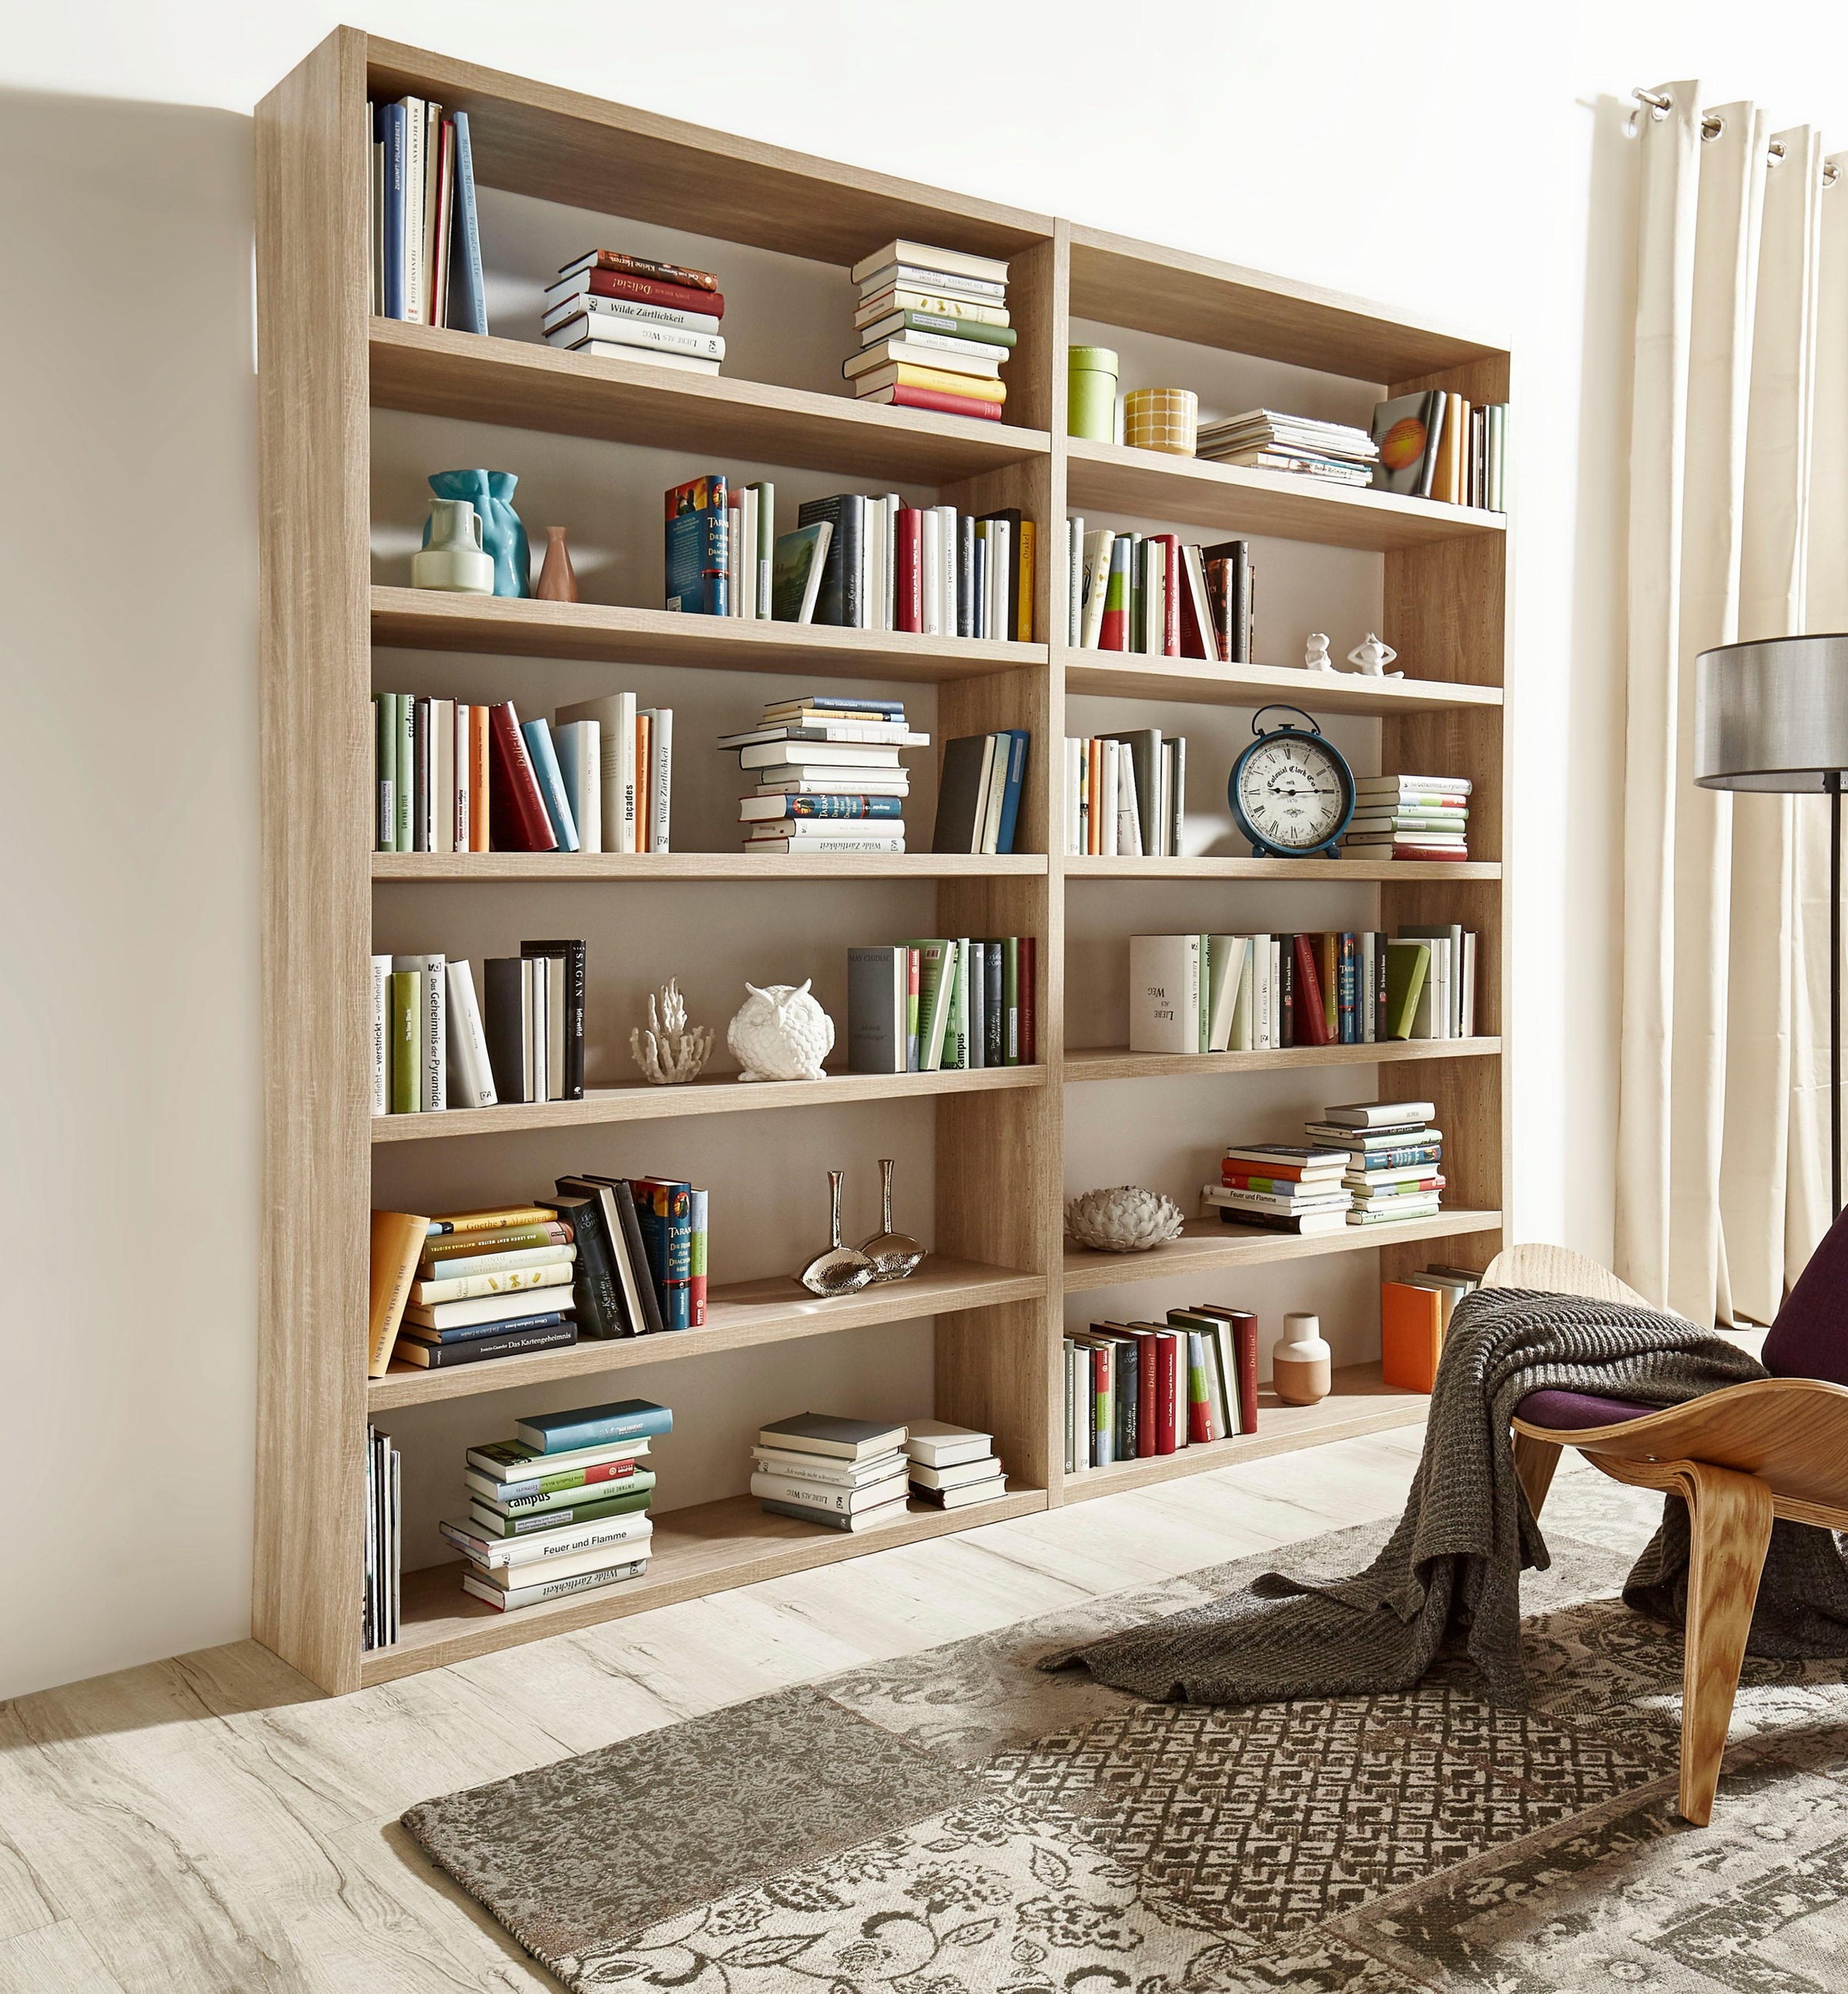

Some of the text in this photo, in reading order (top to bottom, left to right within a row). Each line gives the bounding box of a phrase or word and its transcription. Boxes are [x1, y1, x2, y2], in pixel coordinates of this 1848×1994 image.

[634, 260, 655, 272] Kleine
[612, 278, 652, 295] Delizia!
[611, 303, 684, 323] Wilde Zärtlichkeit
[507, 726, 527, 768] Delizia!
[1267, 766, 1287, 788] Colonial
[1289, 765, 1307, 778] Clock
[660, 747, 669, 824] Wilde Zärtlichkeit
[624, 785, 634, 821] façades
[849, 954, 892, 963] MAY CHIDIAC
[1147, 987, 1165, 998] WEG
[430, 992, 440, 1044] Geheimnis
[1154, 1010, 1174, 1021] LIEBE
[374, 1022, 383, 1066] verstrickt
[429, 1059, 441, 1107] Pyramide
[1230, 1190, 1244, 1199] Feuer
[1256, 1194, 1277, 1203] Flamme
[466, 1221, 498, 1231] Goethe
[668, 1226, 691, 1238] TARAN
[601, 1290, 611, 1307] Kuss
[373, 1265, 407, 1365] DIE MUSIK DER FERNE
[508, 1340, 520, 1349] Das
[521, 1332, 571, 1347] Kartengeheimnis
[1248, 1334, 1257, 1369] Delizia!
[1147, 1353, 1155, 1388] Delizia!
[1068, 1393, 1073, 1404] UM
[615, 1483, 634, 1492] GWYNNE
[786, 1488, 800, 1499] WEG
[507, 1492, 551, 1509] campus
[812, 1494, 828, 1504] LIEBE
[543, 1531, 627, 1555] Feuer und Flamme
[542, 1568, 618, 1596] Wilde Zärtlichkeit
